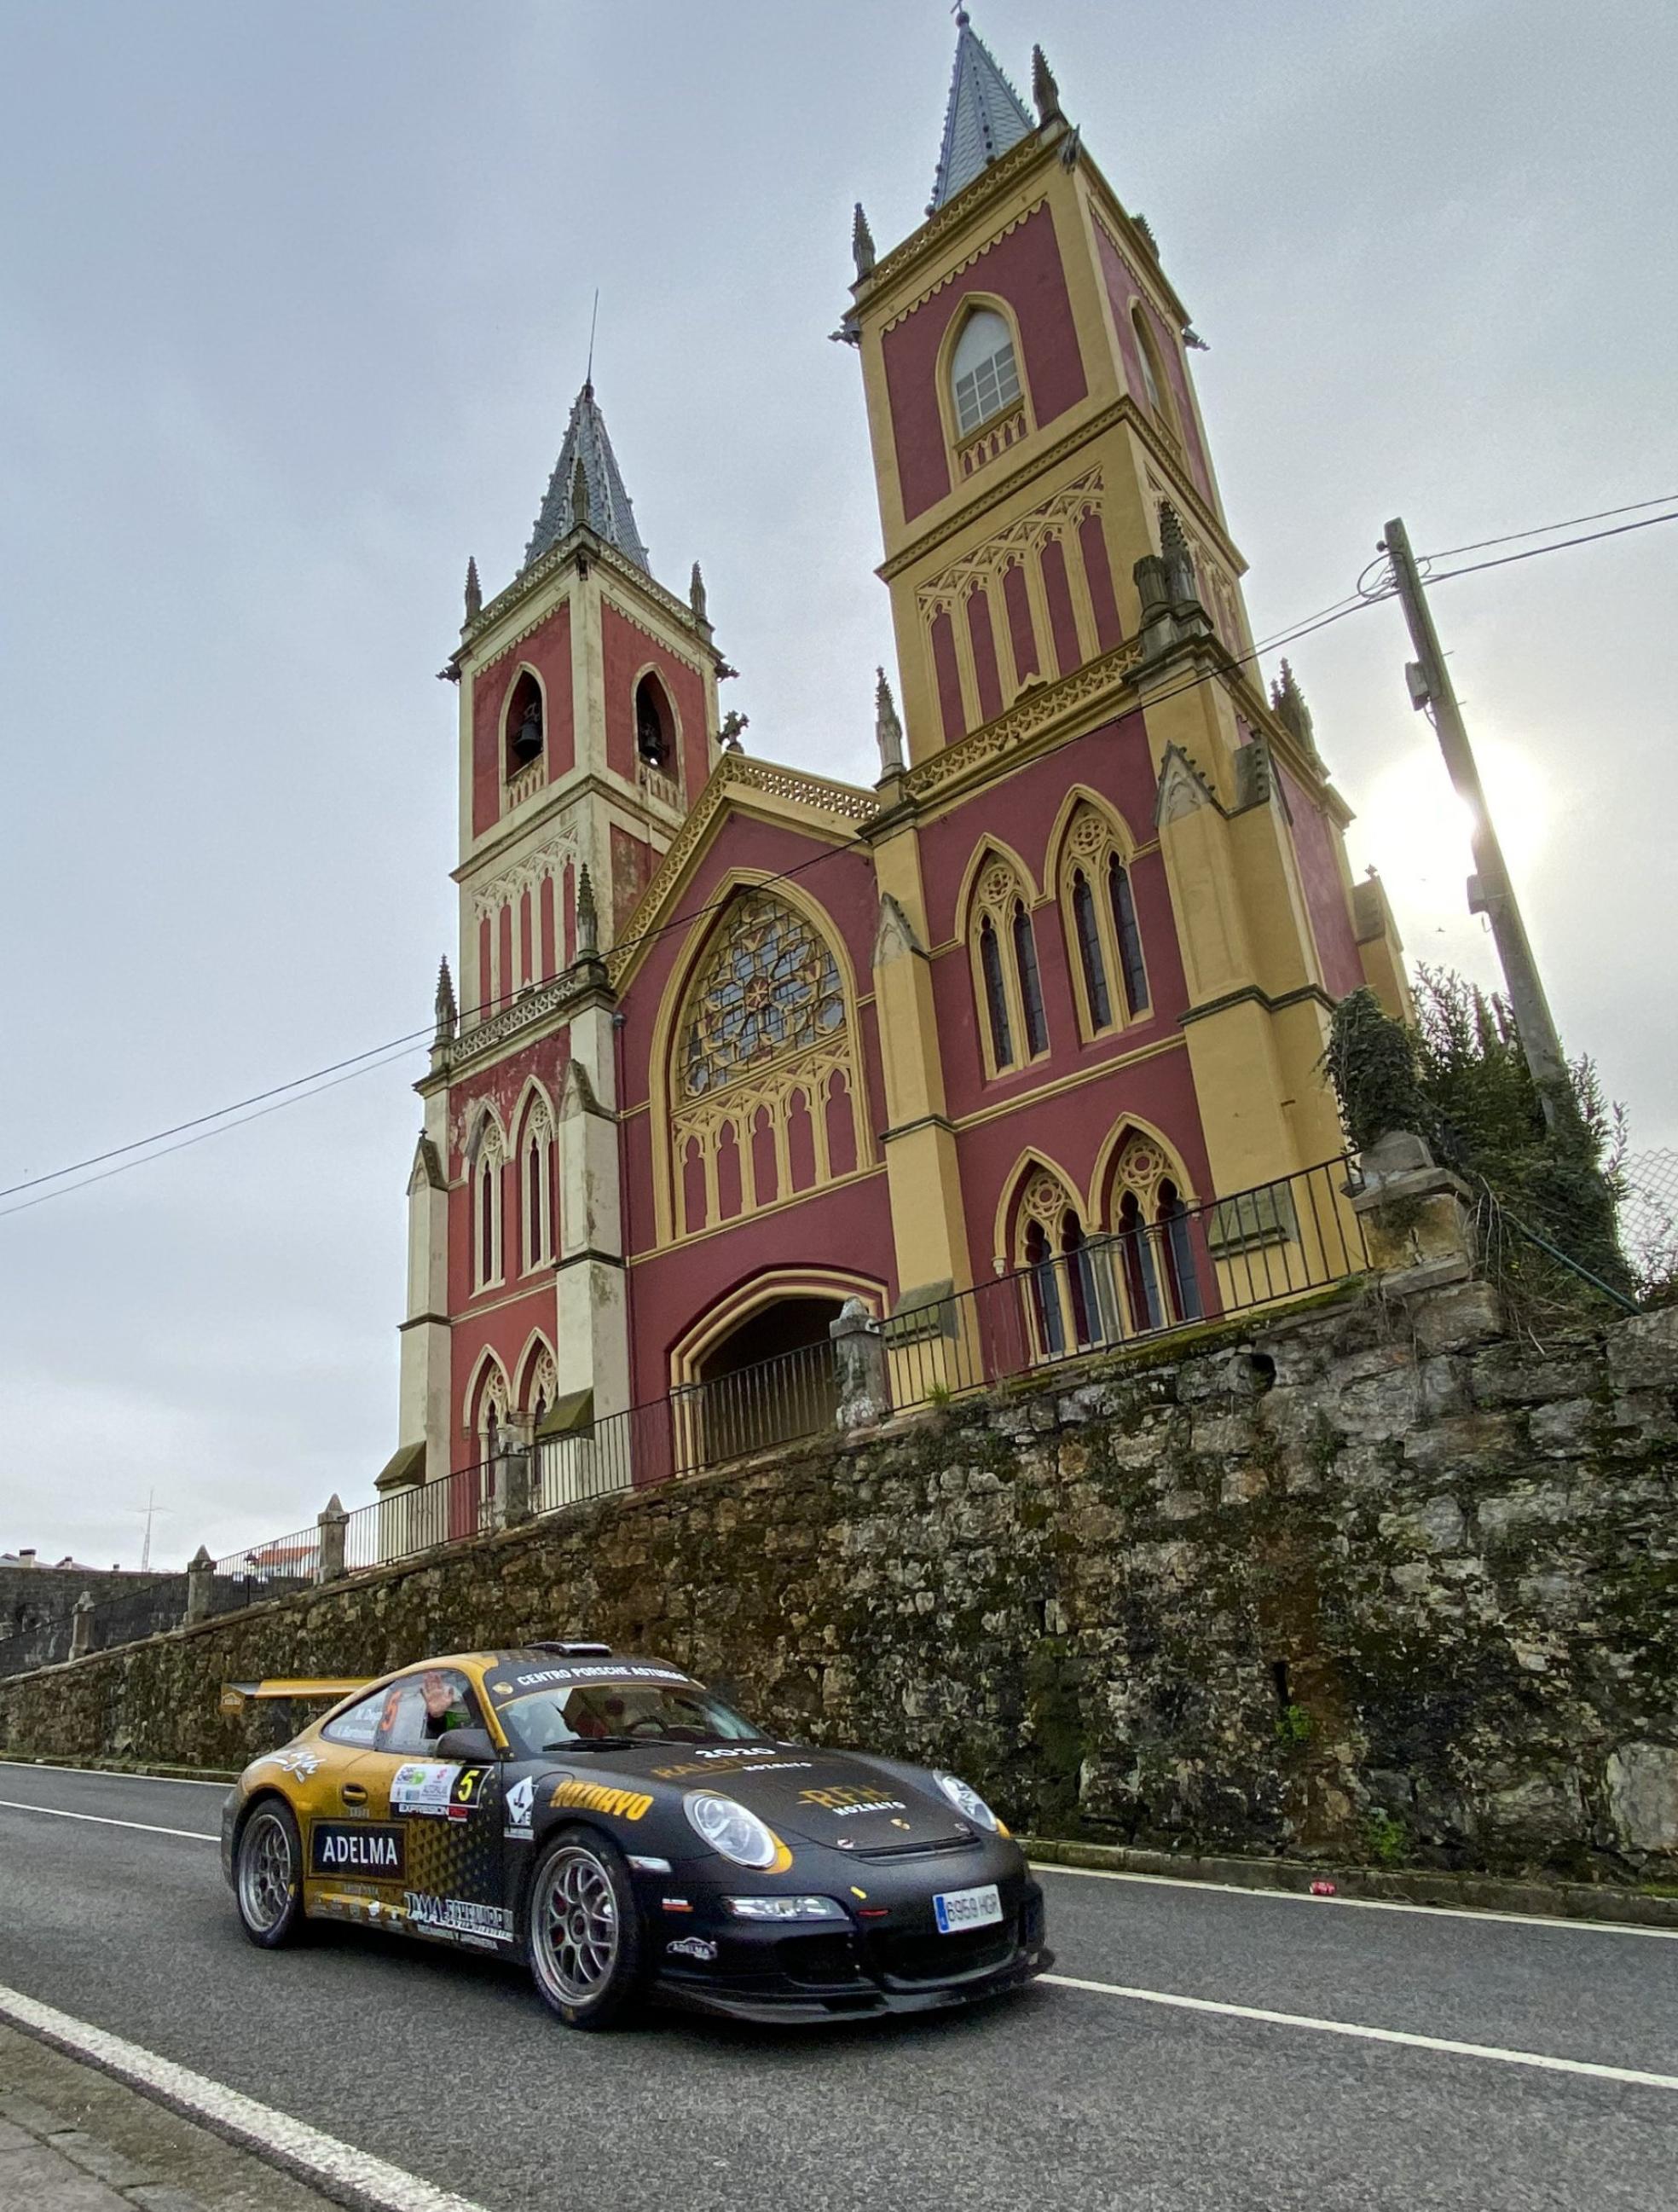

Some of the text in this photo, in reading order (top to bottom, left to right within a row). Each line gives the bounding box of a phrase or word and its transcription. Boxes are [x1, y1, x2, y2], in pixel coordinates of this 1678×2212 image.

[517, 1669, 571, 1686] CENTRO
[571, 1666, 631, 1678] PORSCHE
[381, 1692, 402, 1732] 5
[695, 1747, 777, 1759] 2020
[458, 1769, 480, 1802] 5
[832, 1801, 907, 1816] HOZNAYO
[322, 1836, 398, 1866] ADELMA
